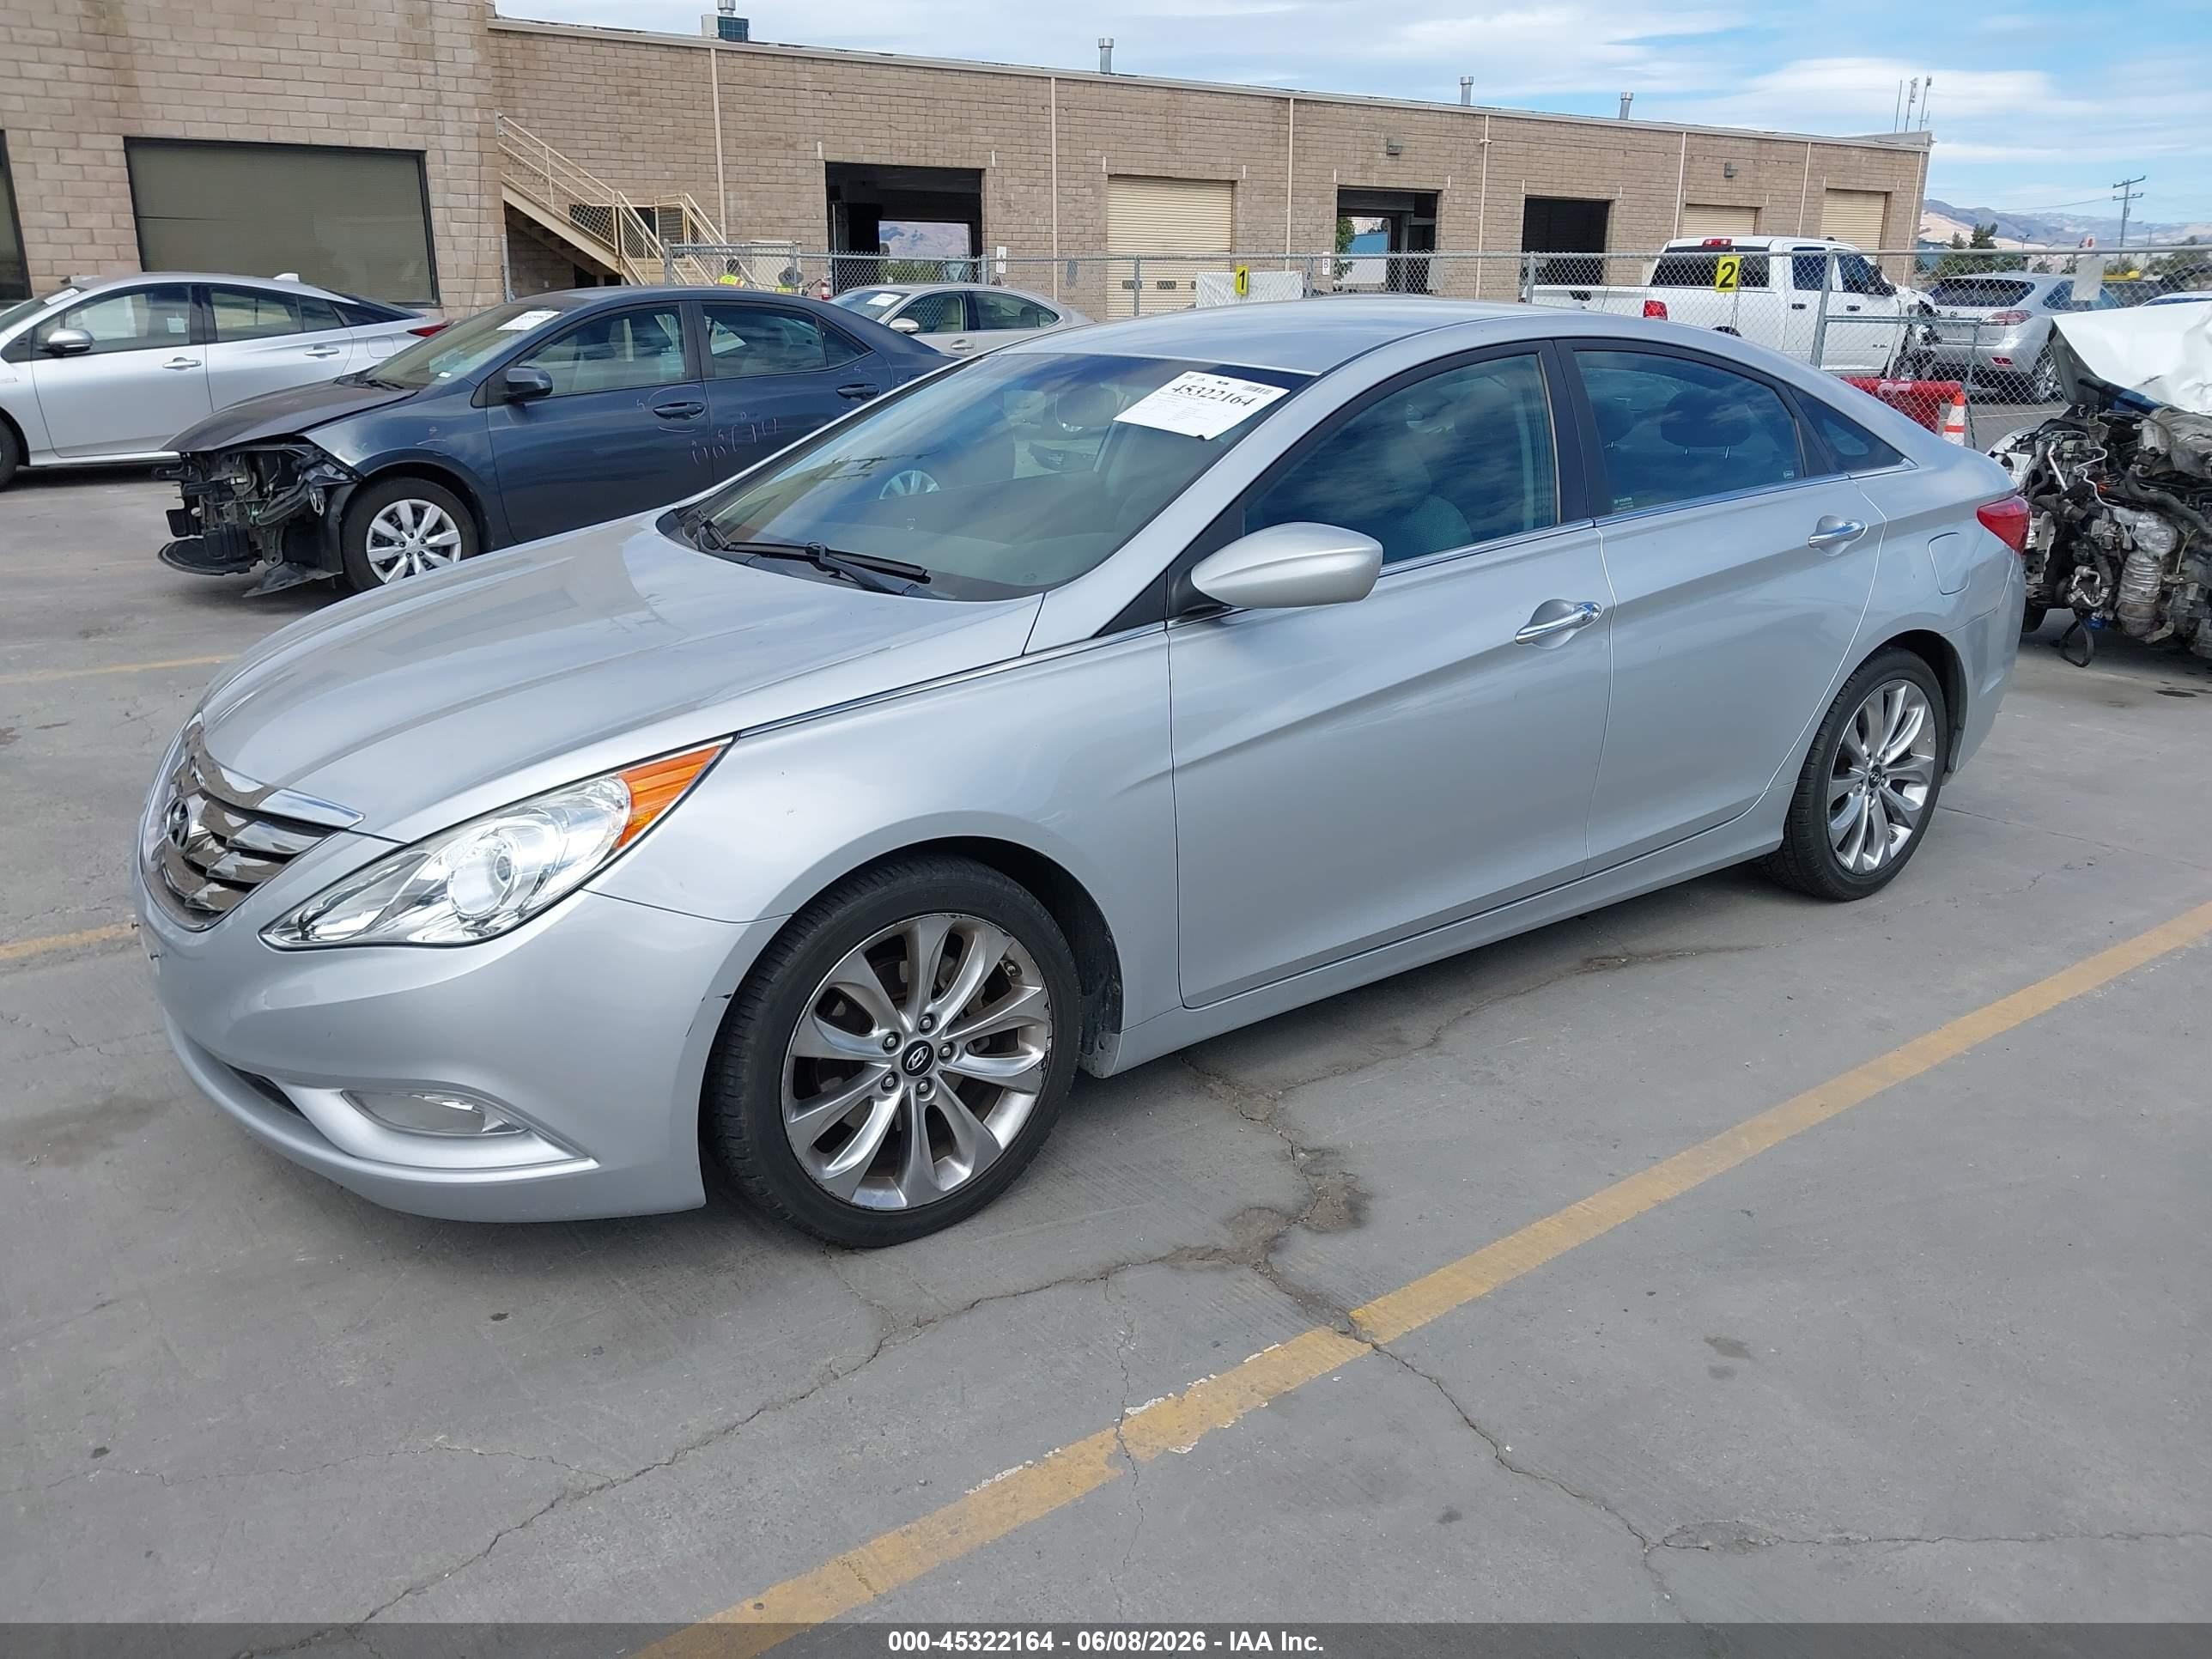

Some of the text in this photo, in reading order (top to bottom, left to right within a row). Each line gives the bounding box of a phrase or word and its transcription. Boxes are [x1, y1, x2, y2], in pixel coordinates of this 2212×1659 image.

[1238, 270, 1246, 290] 1
[1718, 261, 1736, 289] 2
[1171, 384, 1257, 406] 45322164
